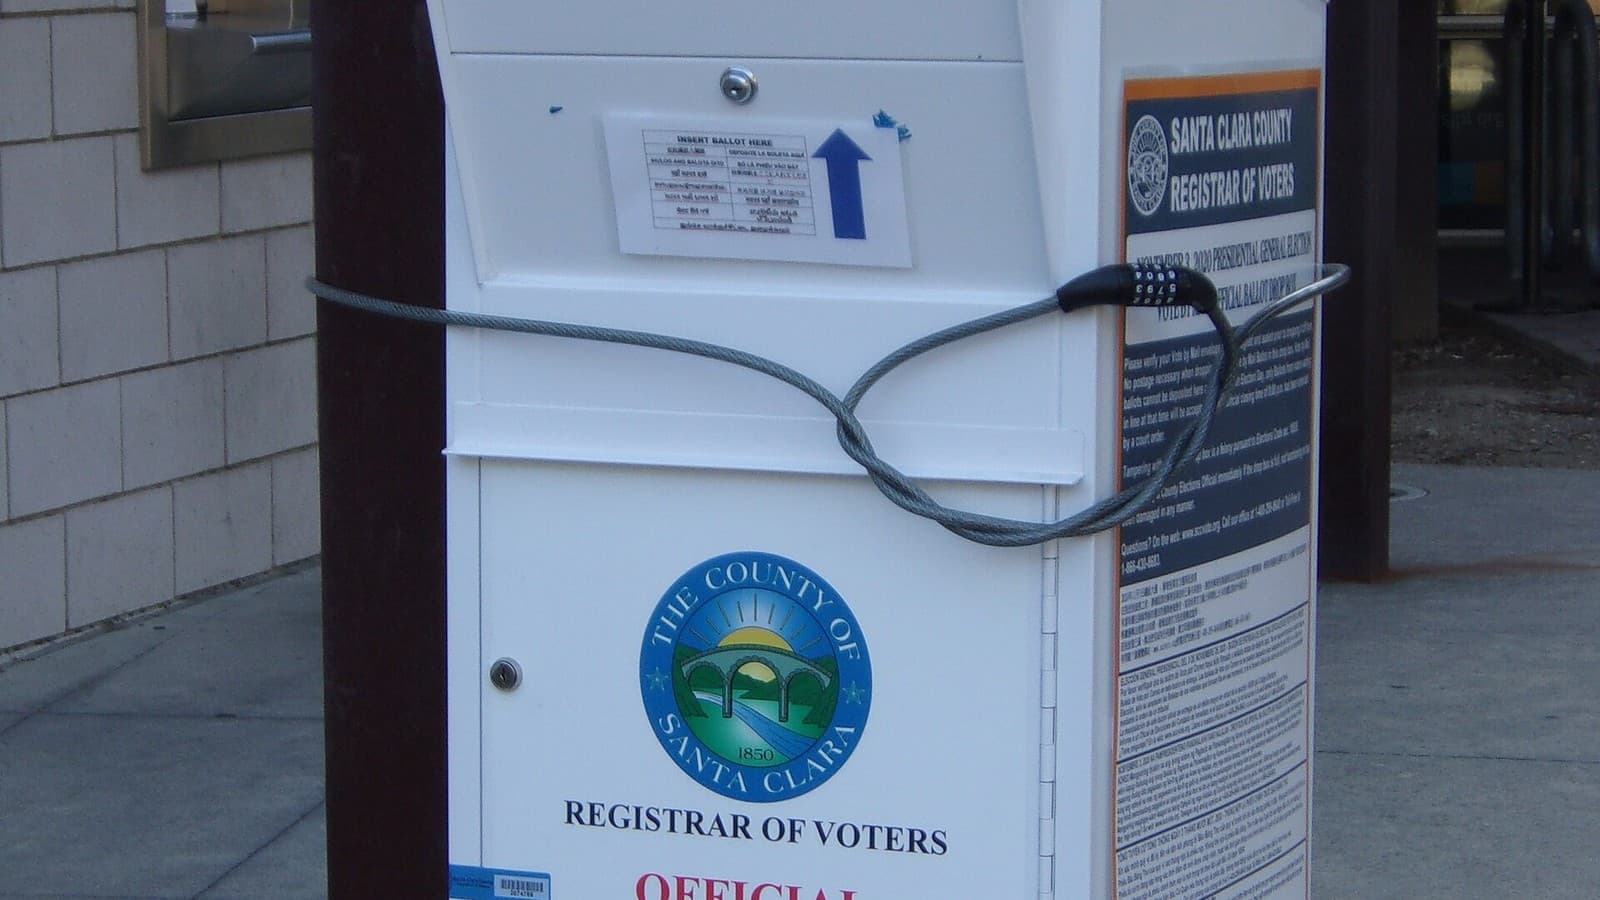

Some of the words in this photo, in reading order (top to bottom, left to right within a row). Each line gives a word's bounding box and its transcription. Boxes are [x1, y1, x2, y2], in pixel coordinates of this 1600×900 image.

[676, 134, 710, 144] INSERT
[711, 136, 746, 146] BALLOT
[747, 138, 773, 147] HERE
[1171, 115, 1215, 154] SANTA
[1217, 111, 1251, 150] CLARA
[1253, 108, 1293, 146] COUNTY
[1171, 169, 1240, 212] REGISTRAR
[1242, 167, 1256, 203] OF
[1258, 162, 1295, 201] VOTERS
[1213, 241, 1259, 271] PRESIDENTIAL
[1260, 236, 1285, 263] GENERAL
[1286, 231, 1311, 257] ELECTION
[1218, 284, 1241, 312] FFICIAL
[1243, 279, 1267, 307] BALLOT
[1123, 358, 1143, 371] Please
[1142, 353, 1159, 368] verify
[1132, 376, 1154, 392] postage
[1154, 371, 1181, 385] necessary
[1122, 463, 1151, 479] Tampering
[1160, 485, 1178, 498] County
[1178, 480, 1201, 494] Elections
[1200, 473, 1217, 488] Official
[1135, 507, 1160, 524] damaged
[1159, 534, 1169, 546] the
[652, 586, 699, 646] THE
[705, 561, 834, 612] COUNTY
[829, 618, 861, 661] OF
[658, 713, 747, 792] SANTA
[763, 725, 856, 793] CLARA
[737, 746, 774, 761] 1850
[564, 799, 753, 841] REGISTRAR
[761, 816, 807, 844] OF
[813, 820, 949, 856] VOTERS
[635, 872, 858, 900] OFFI
